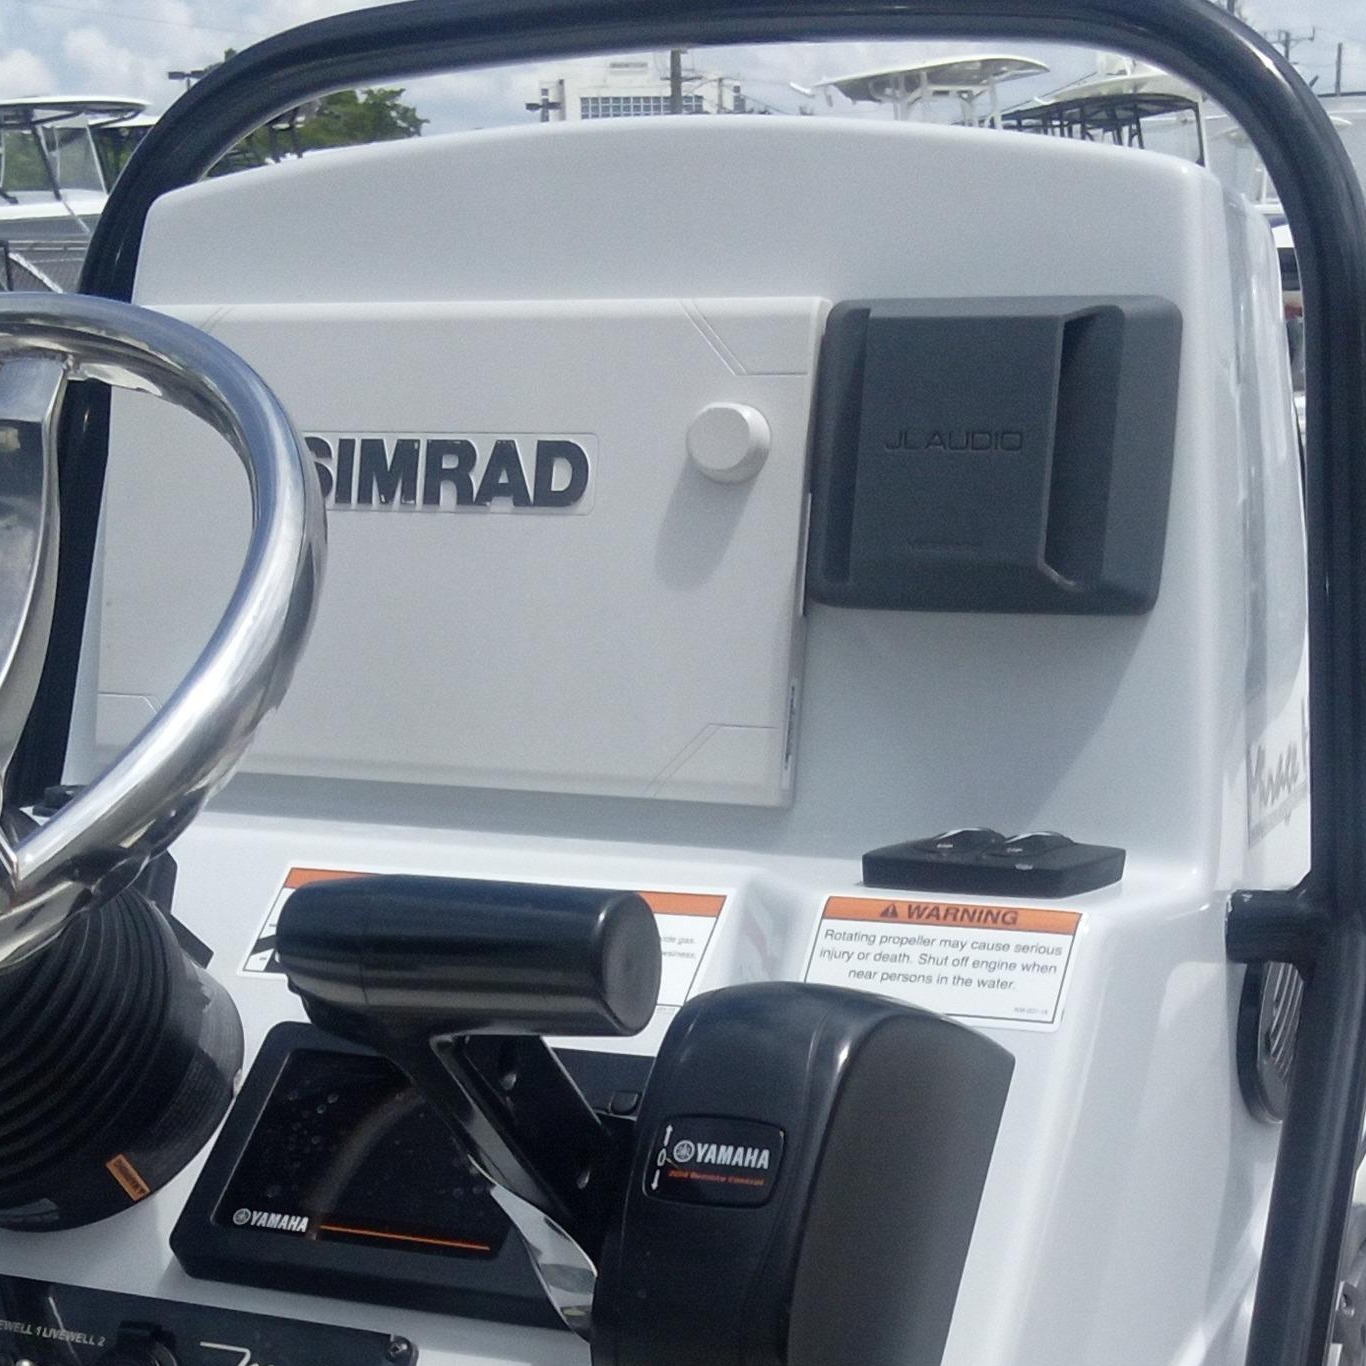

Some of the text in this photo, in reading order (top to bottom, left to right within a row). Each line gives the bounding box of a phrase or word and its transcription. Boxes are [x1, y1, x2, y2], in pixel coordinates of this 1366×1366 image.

[924, 431, 1023, 450] AUDIO
[304, 437, 590, 507] SIMRAD
[907, 903, 1019, 926] WARNING
[824, 928, 1063, 957] Rotating propeller may cause serious
[819, 947, 1058, 975] injury or death. Shut off engine when
[847, 968, 1017, 990] near persons in the water.
[695, 1142, 771, 1170] YAMAHA
[250, 1210, 310, 1233] YAMAHA
[42, 1328, 96, 1346] LIVEWELL
